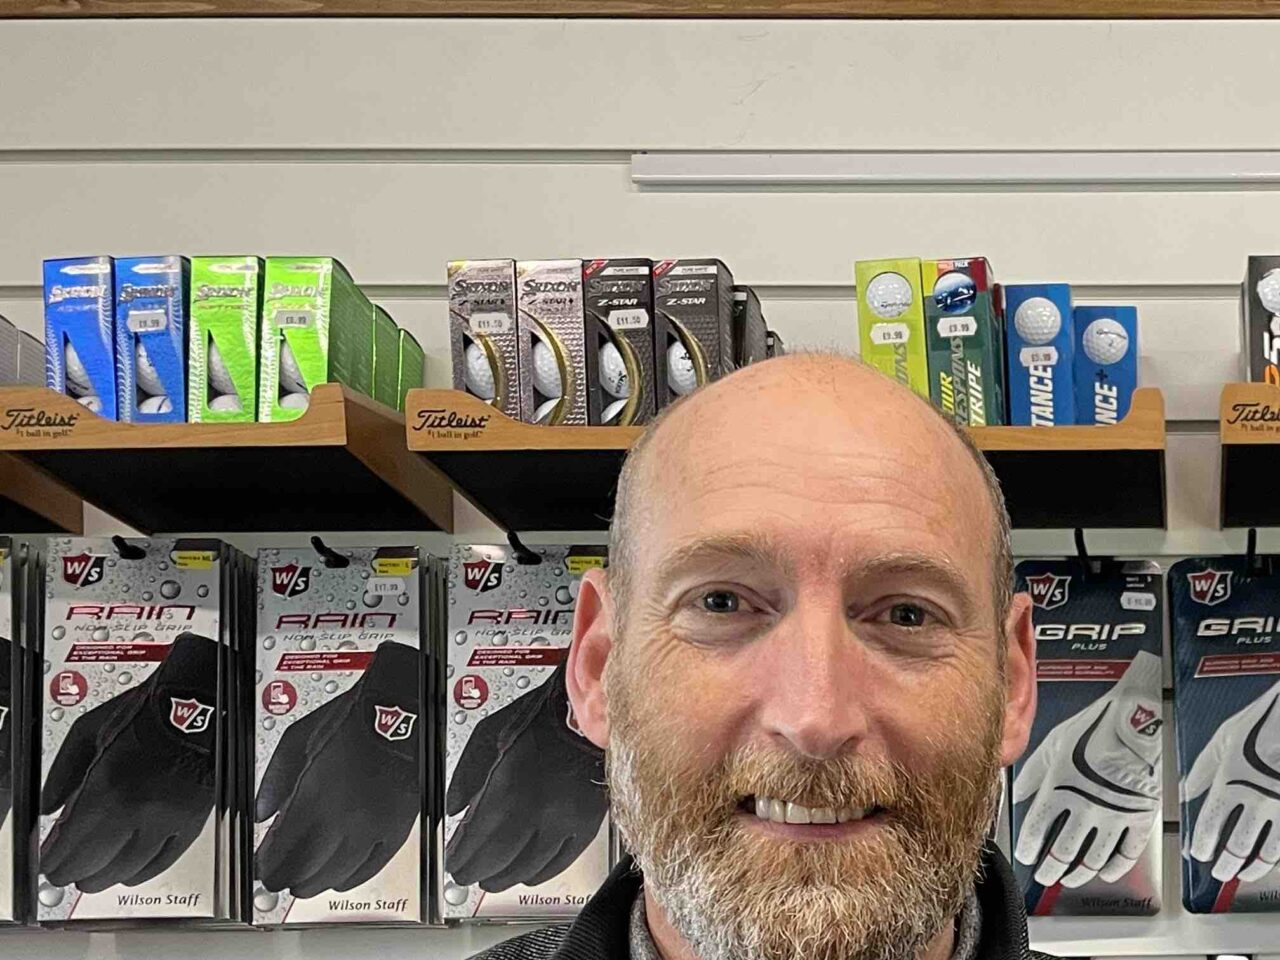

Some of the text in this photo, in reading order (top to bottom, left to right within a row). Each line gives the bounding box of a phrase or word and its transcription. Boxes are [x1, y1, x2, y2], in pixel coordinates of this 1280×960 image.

[521, 279, 580, 299] SRIXON
[597, 297, 638, 307] Z-STAR
[666, 297, 706, 307] Z-STAR
[1, 408, 79, 430] Titleist
[412, 409, 491, 431] Titleist
[66, 605, 195, 620] RAIN
[74, 623, 193, 632] NON-SLIP GRIP
[275, 613, 397, 630] RAIN
[283, 633, 352, 641] NON-SLIP
[475, 628, 544, 636] NON-SLIP
[1035, 624, 1146, 640] GRIP
[1072, 643, 1108, 651] PLUS
[1236, 637, 1272, 645] PLUS
[118, 893, 201, 908] Wilson Staff
[328, 899, 408, 912] Wilson Staff
[519, 894, 560, 905] Wilson
